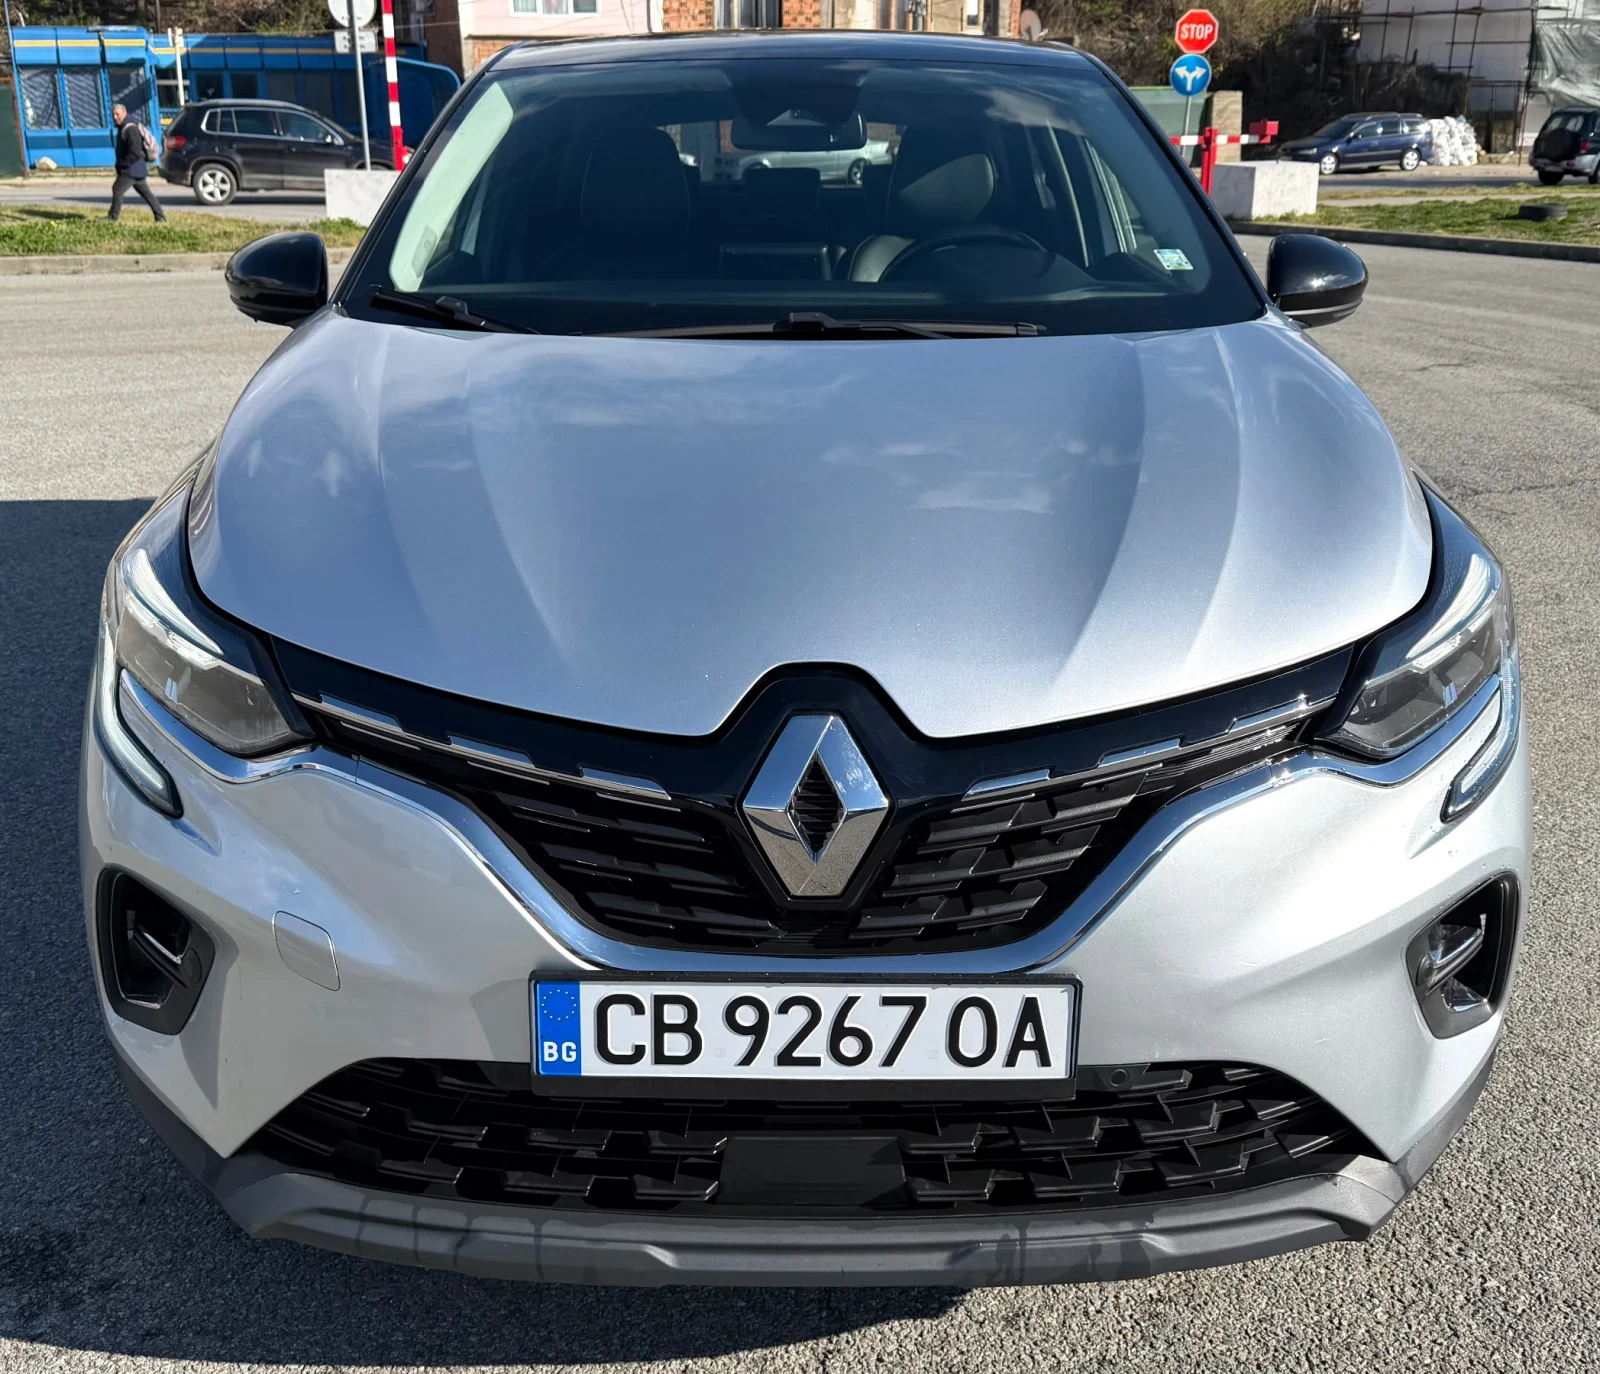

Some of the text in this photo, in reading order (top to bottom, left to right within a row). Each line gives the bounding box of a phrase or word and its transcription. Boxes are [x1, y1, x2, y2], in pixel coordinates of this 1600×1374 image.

[1181, 23, 1213, 40] STOP
[596, 993, 1052, 1068] CB 9267 OA
[542, 1040, 578, 1063] BG
